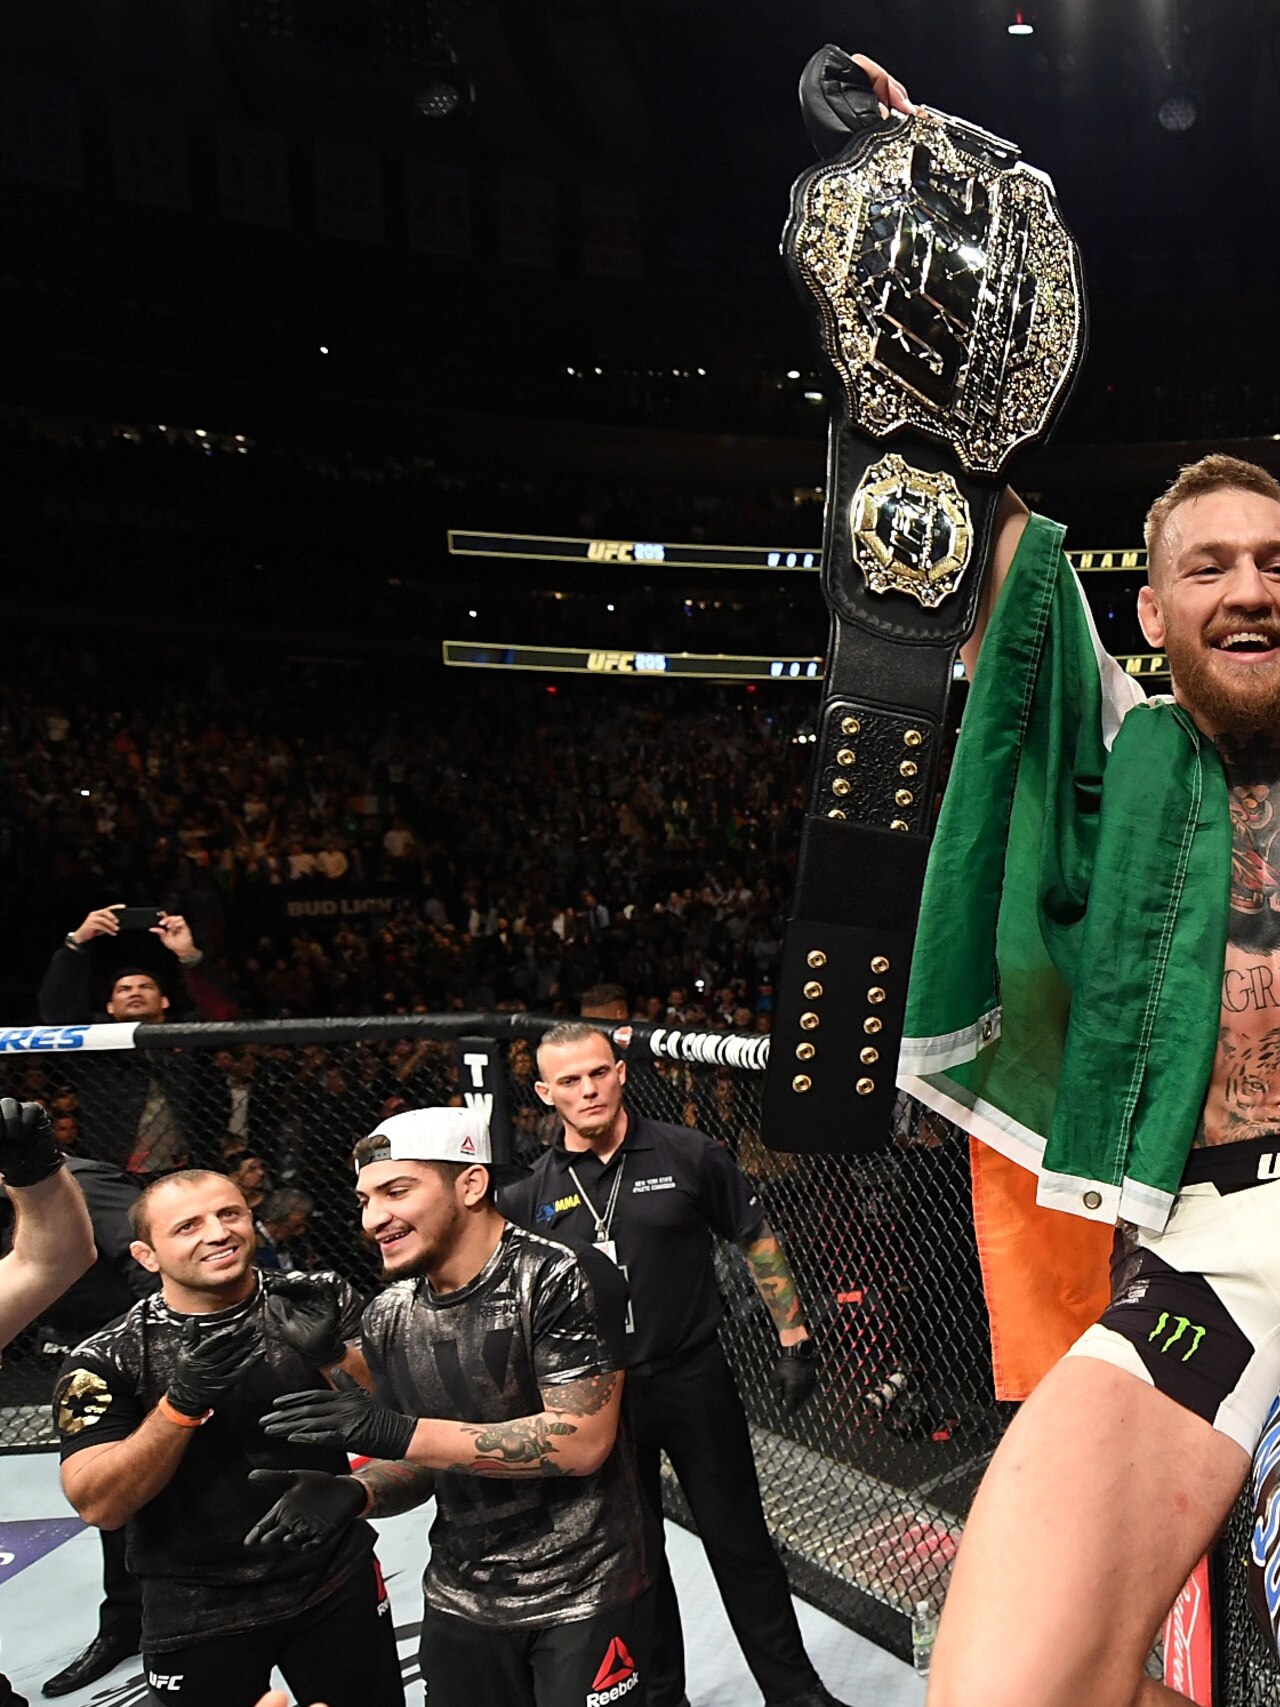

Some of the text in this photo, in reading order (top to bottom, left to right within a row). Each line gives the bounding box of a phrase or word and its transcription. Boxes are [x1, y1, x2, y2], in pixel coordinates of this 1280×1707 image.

[588, 542, 633, 561] UFC
[588, 653, 634, 672] UFC
[287, 899, 338, 918] BUD
[555, 1194, 581, 1212] MMA
[149, 1671, 184, 1691] UFC
[586, 1672, 639, 1707] Reebok
